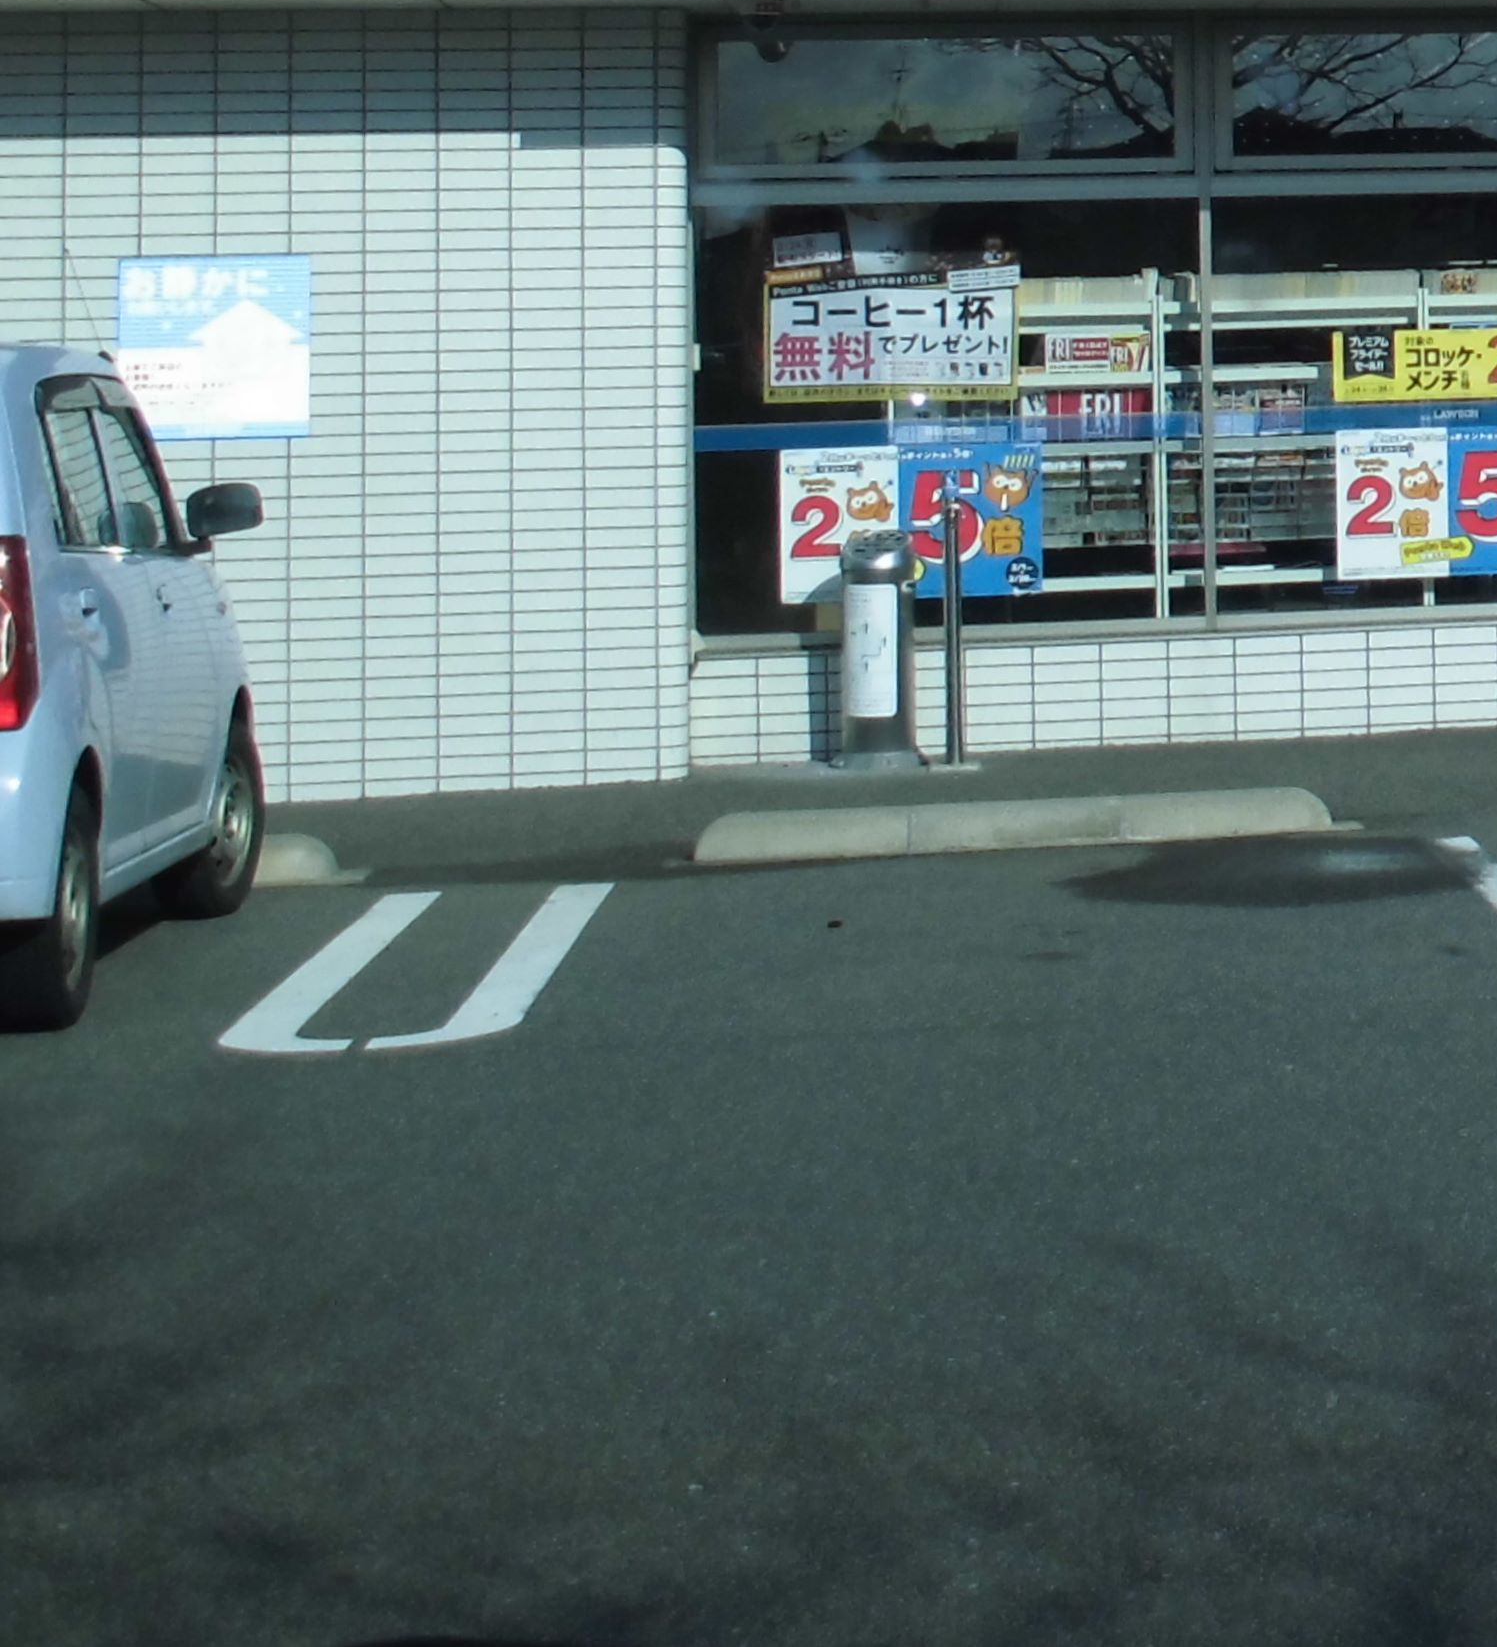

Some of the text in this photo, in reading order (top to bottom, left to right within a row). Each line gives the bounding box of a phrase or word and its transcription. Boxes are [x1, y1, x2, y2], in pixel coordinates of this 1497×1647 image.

[792, 295, 995, 331] コーヒー1杯
[773, 331, 876, 382] 無料
